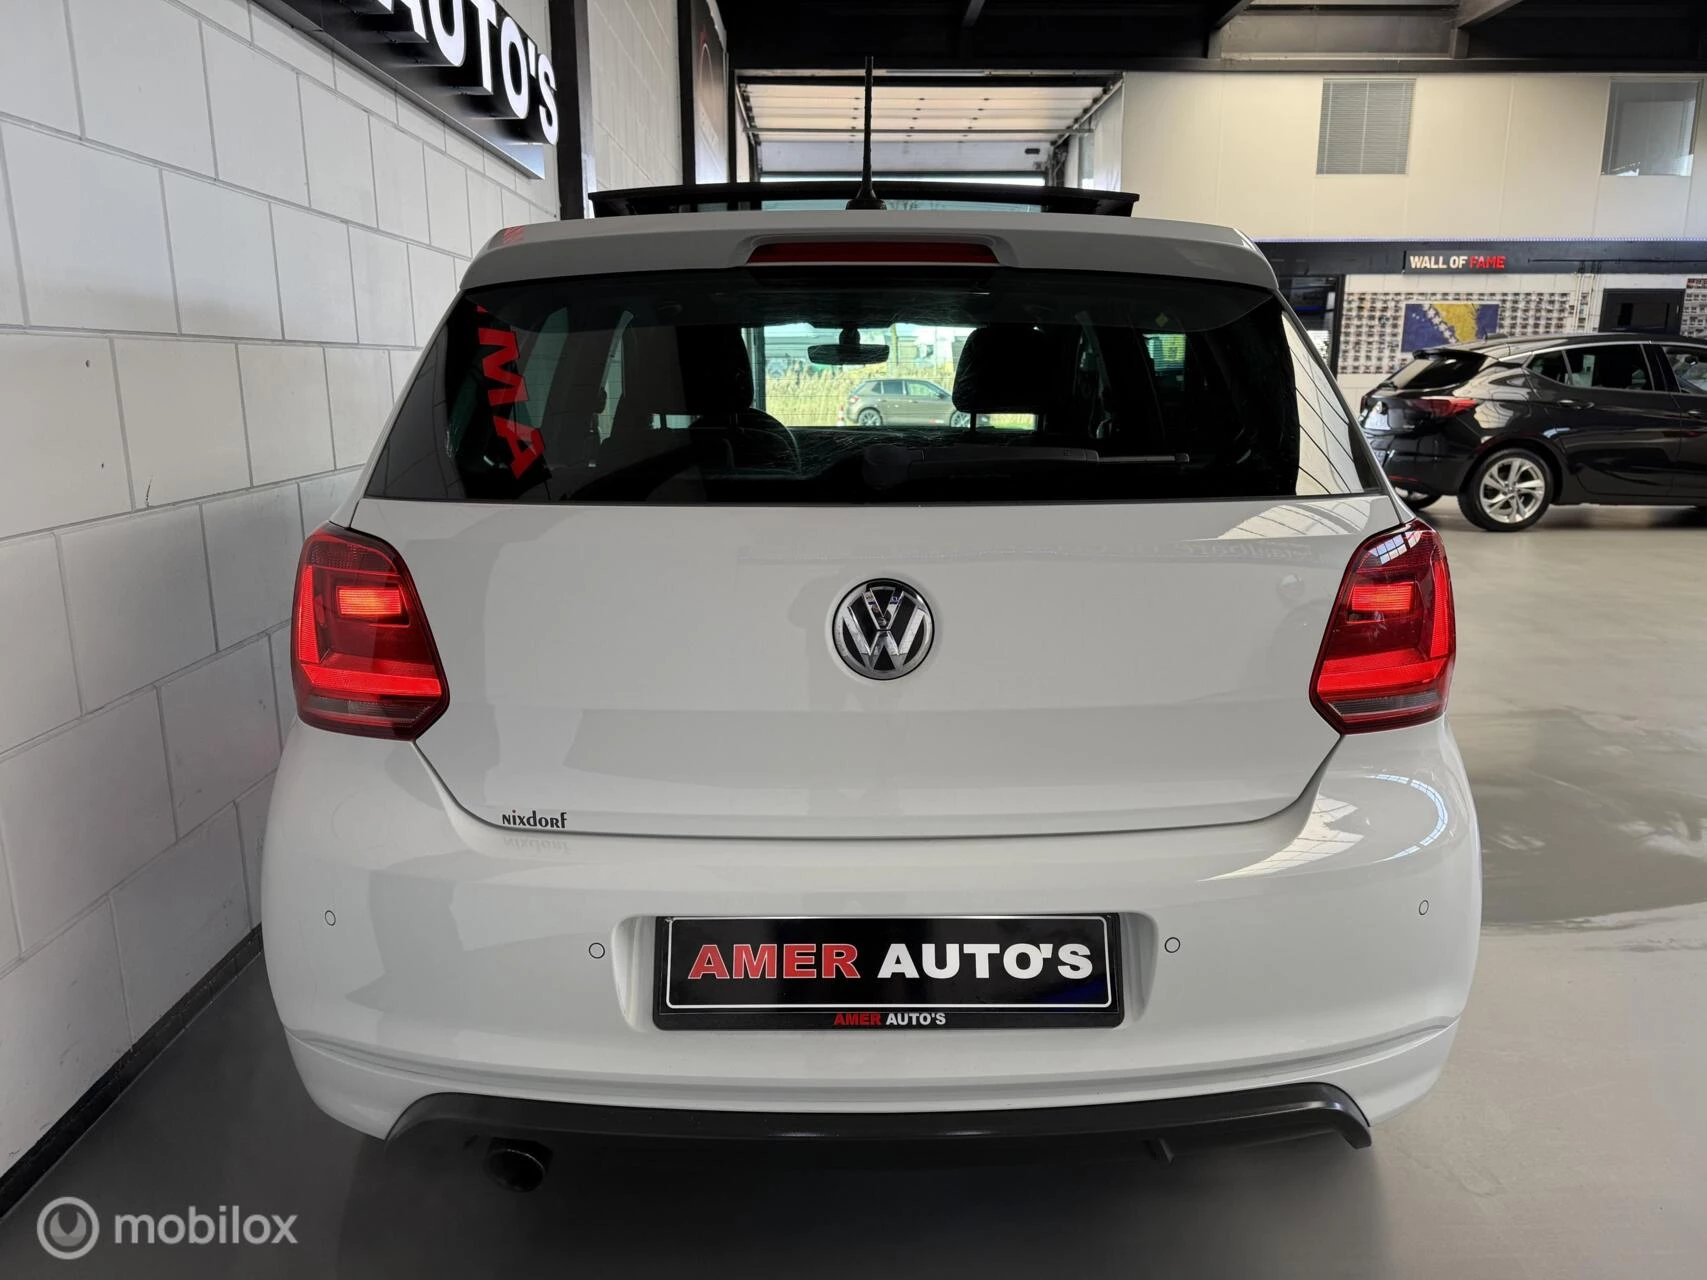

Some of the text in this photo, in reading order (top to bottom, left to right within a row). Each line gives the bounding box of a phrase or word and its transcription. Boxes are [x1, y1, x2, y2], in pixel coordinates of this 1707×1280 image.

[1409, 255, 1506, 269] WALL OF FAME
[687, 943, 1094, 979] AMER AUTO'S
[833, 1012, 946, 1026] AMER AUTO'S
